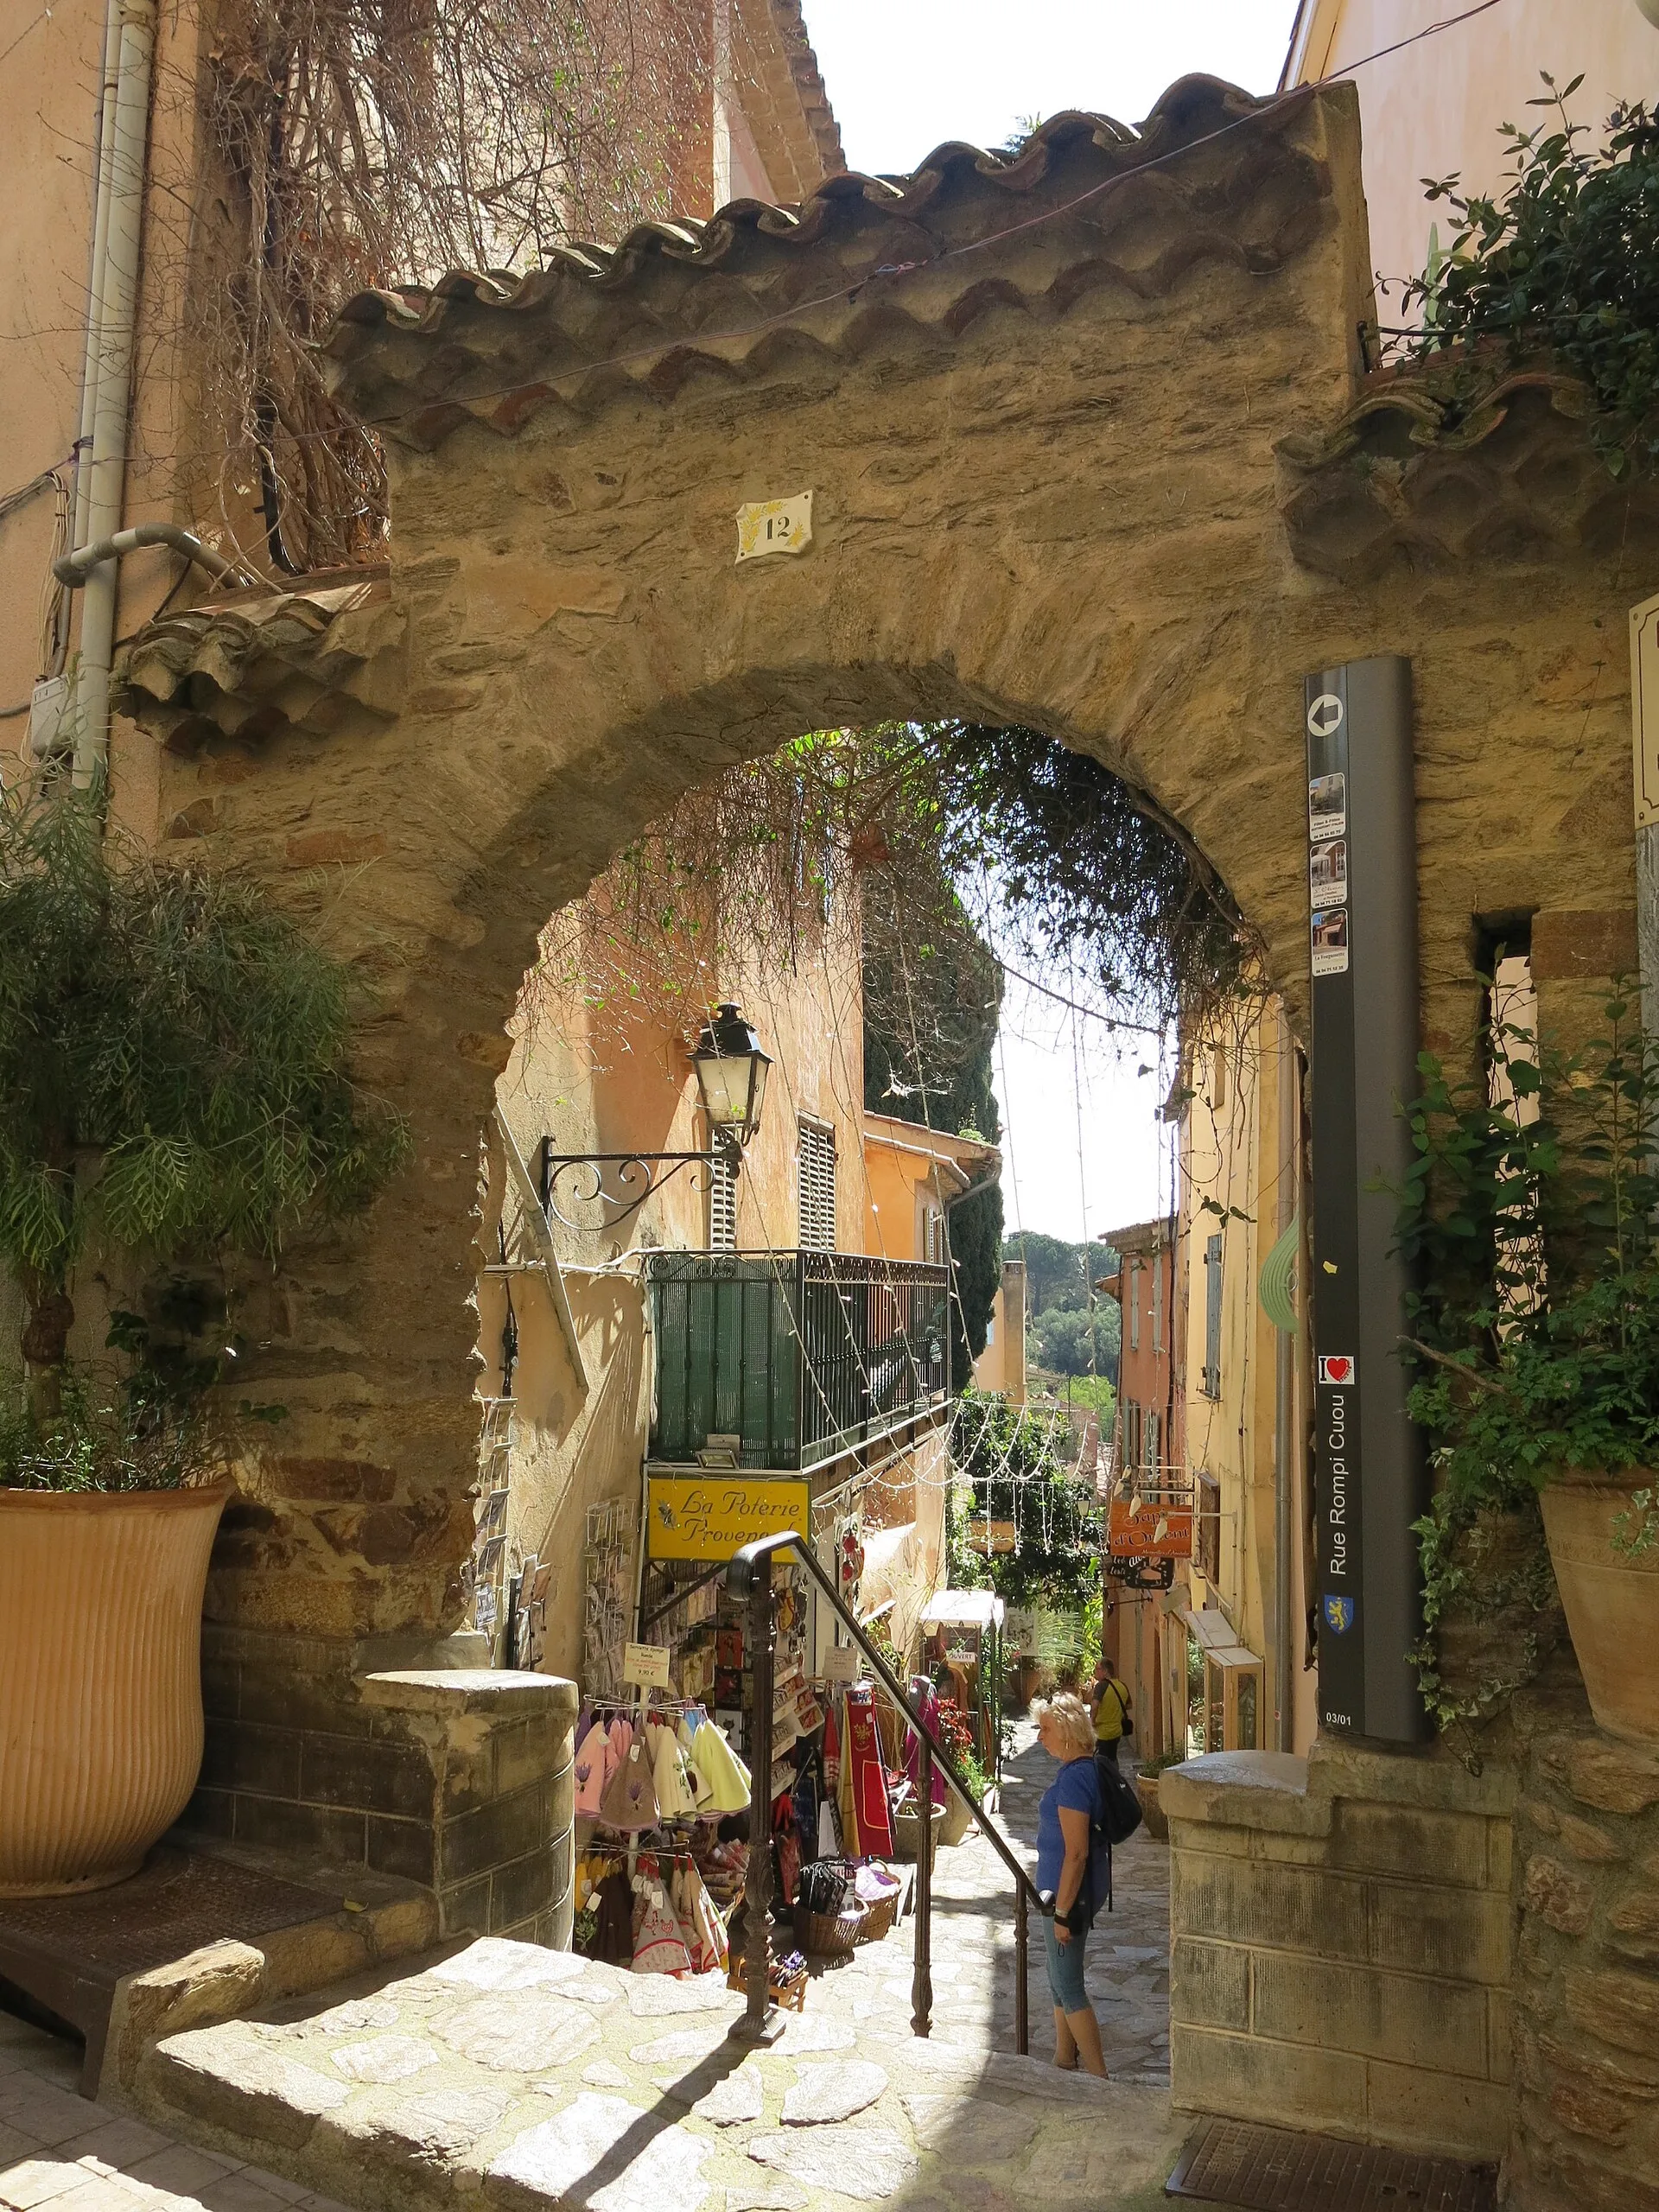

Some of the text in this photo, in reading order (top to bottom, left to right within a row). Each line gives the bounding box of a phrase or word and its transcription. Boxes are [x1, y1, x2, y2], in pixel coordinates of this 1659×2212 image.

[766, 516, 791, 540] 12
[1319, 1357, 1327, 1381] I
[1329, 1395, 1350, 1575] Rue Rompi Cuou
[680, 1491, 800, 1516] La Poterie
[1114, 1527, 1190, 1547] d'Orent
[1326, 1712, 1351, 1726] 03/01
